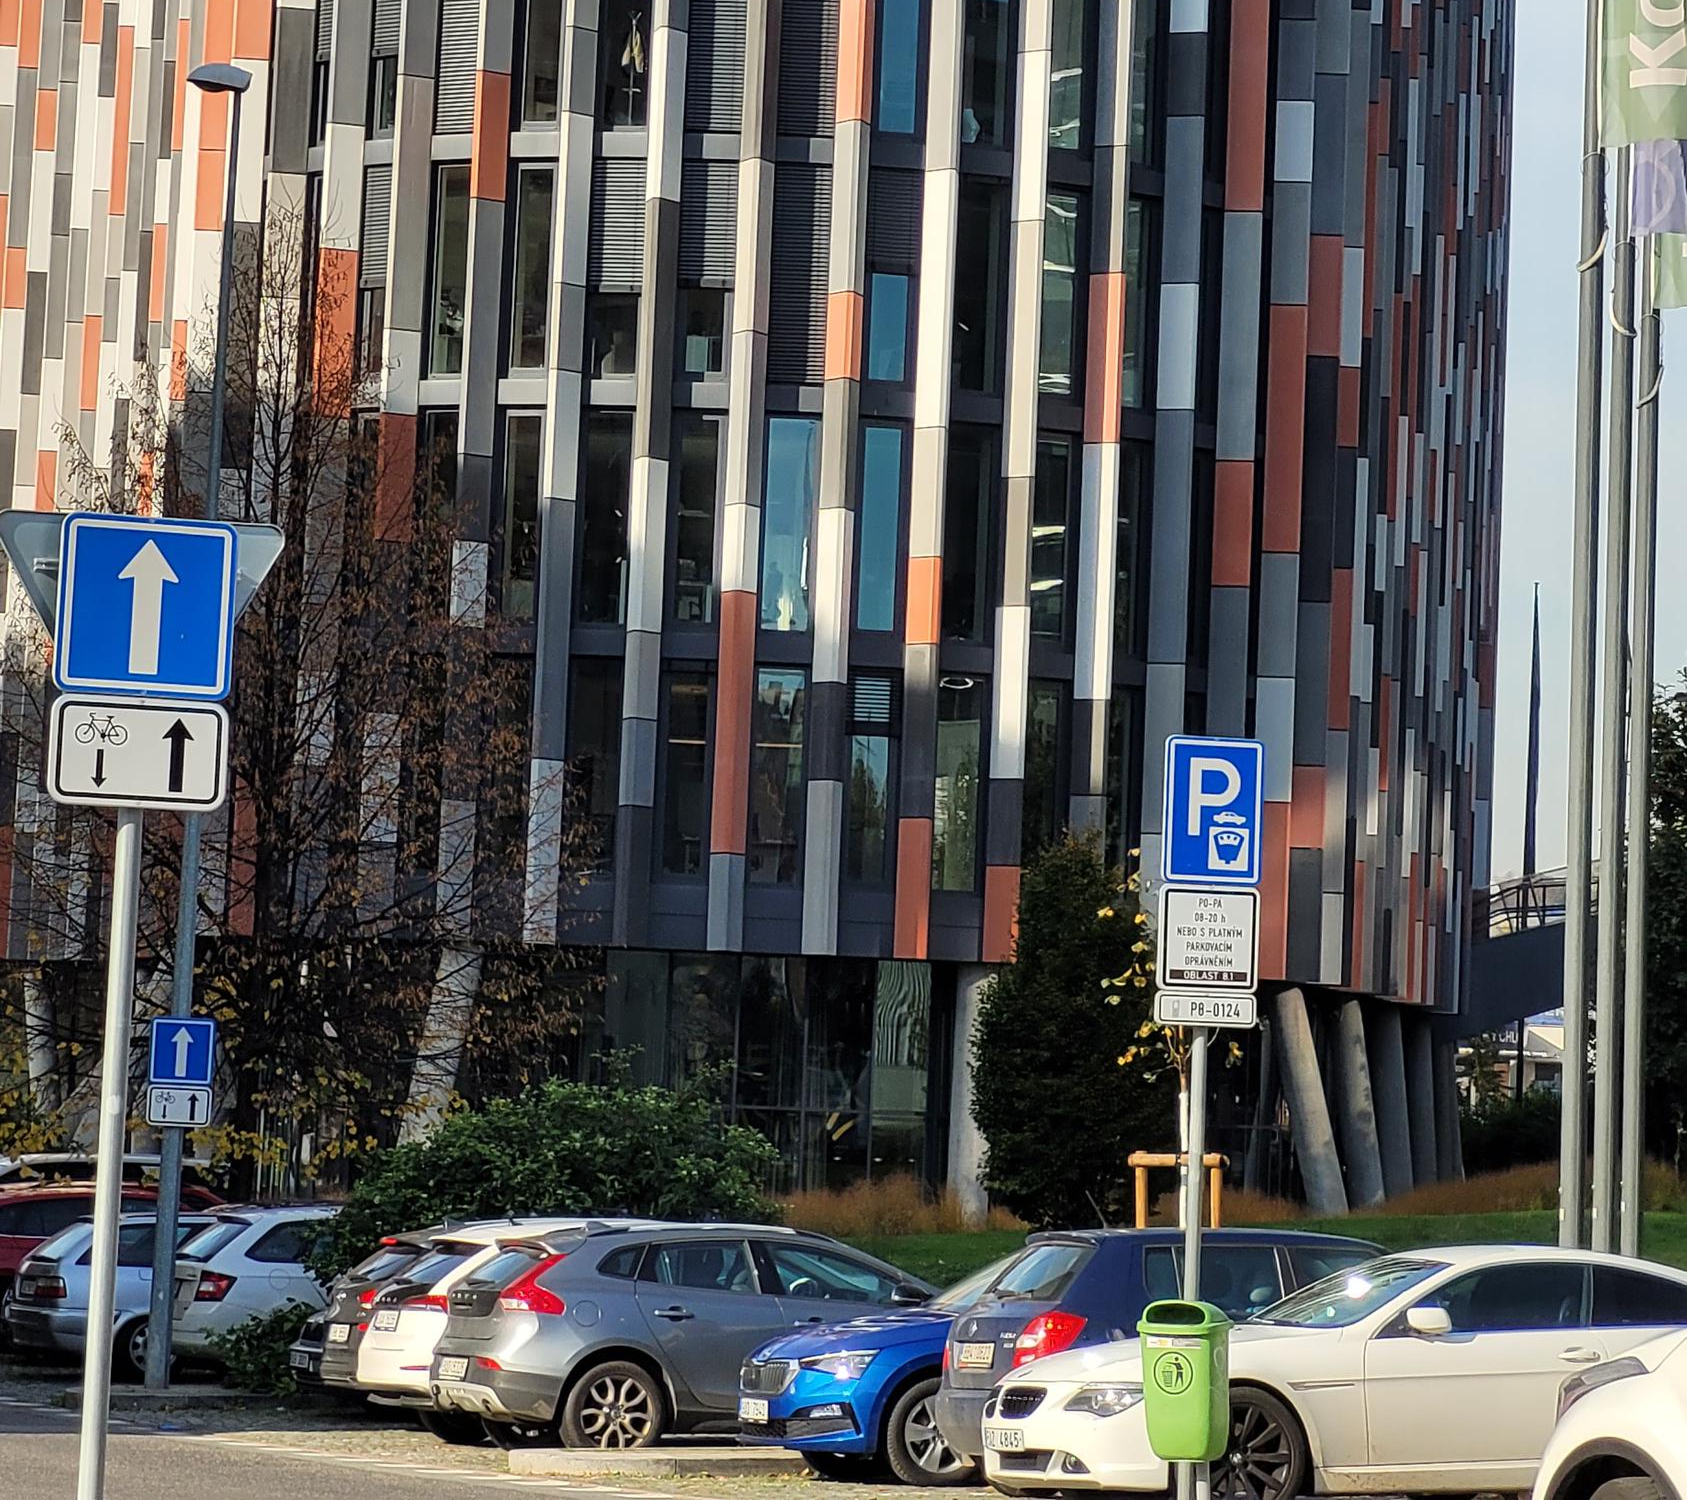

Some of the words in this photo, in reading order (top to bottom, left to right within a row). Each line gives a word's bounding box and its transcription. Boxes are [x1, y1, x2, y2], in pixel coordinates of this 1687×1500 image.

[1187, 756, 1242, 837] P
[1194, 912, 1218, 923] 08-20
[1220, 914, 1226, 923] h
[1177, 926, 1197, 937] NEBO
[1200, 927, 1206, 937] S
[1209, 927, 1242, 938] PLATNÝM
[1186, 941, 1232, 952] PARKOVACÍM
[1185, 955, 1232, 967] OPRÁVNĚNÍM
[1183, 971, 1219, 981] OBLAST
